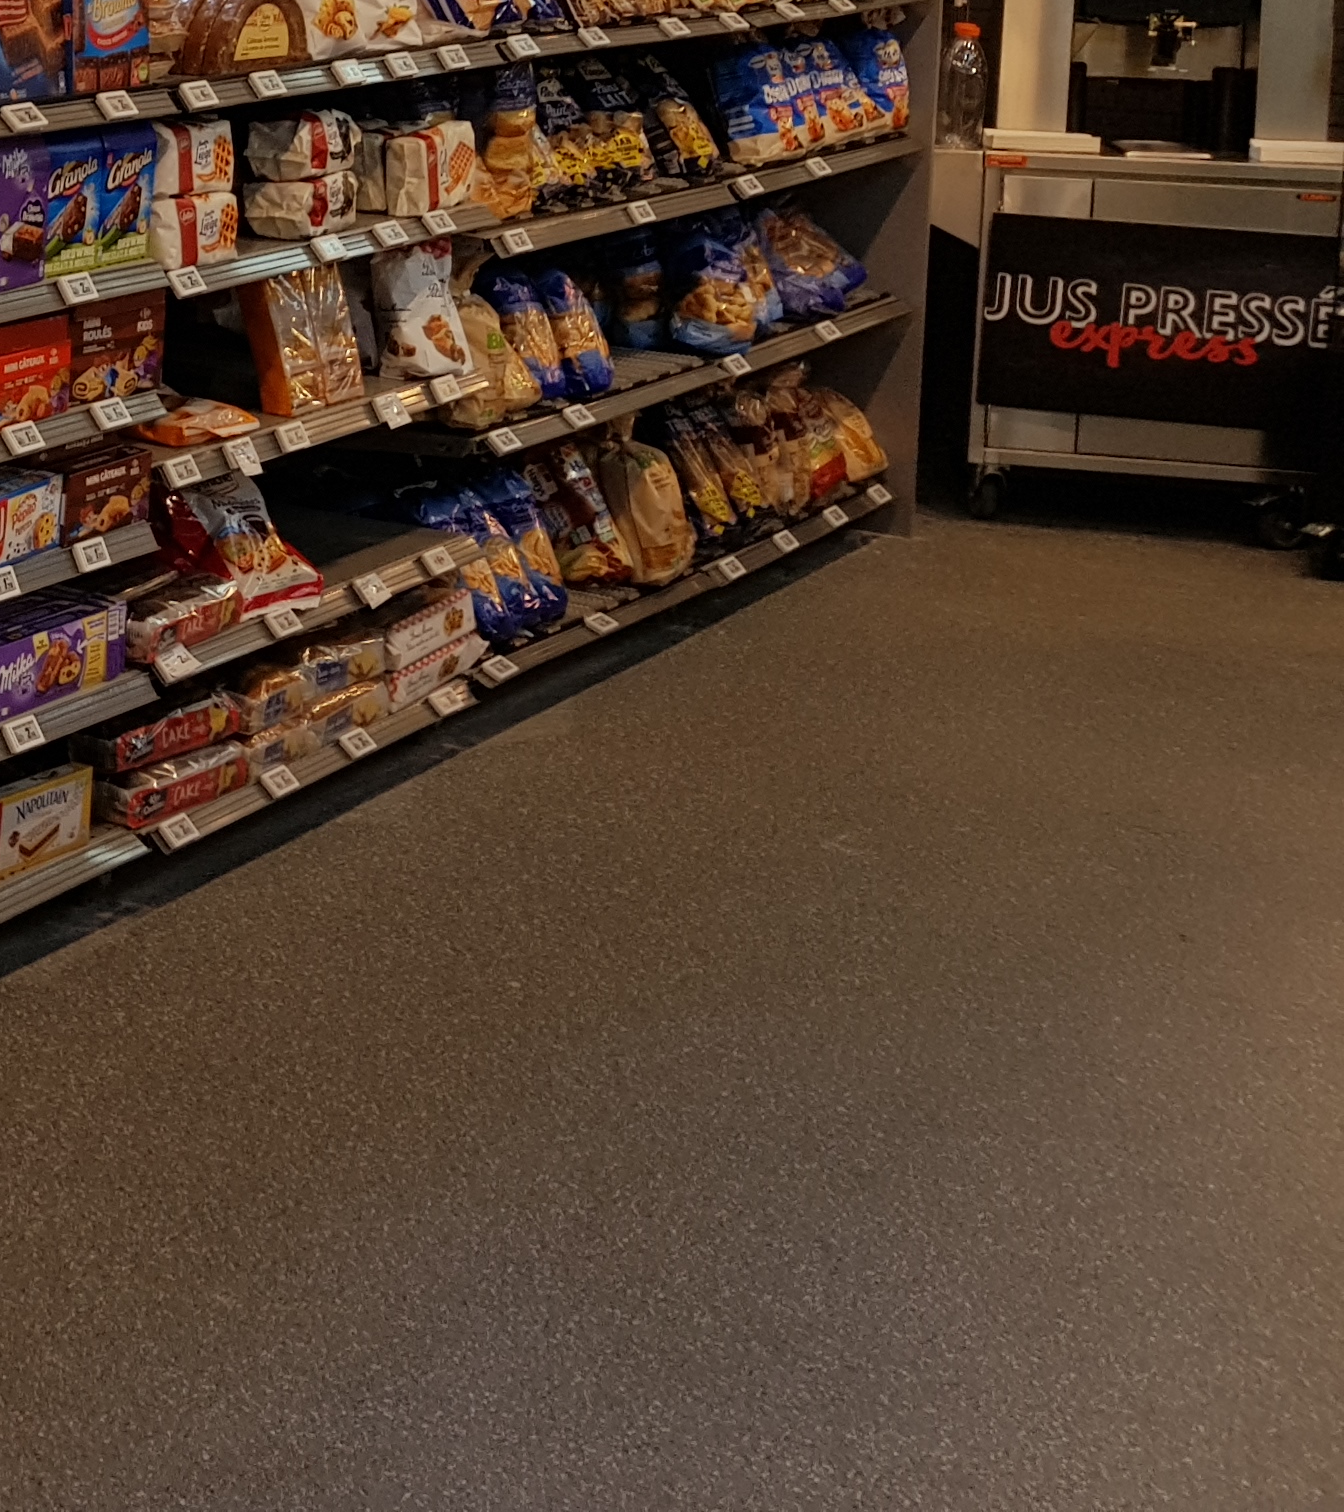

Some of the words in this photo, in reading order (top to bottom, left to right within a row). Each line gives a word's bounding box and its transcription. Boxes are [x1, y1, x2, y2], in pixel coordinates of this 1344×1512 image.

[47, 155, 99, 198] Granola
[106, 147, 153, 191] Granola
[983, 271, 1098, 329] JUS
[1049, 319, 1259, 368] express
[162, 721, 192, 747] CAKE
[15, 789, 71, 824] NAPOLITAIN
